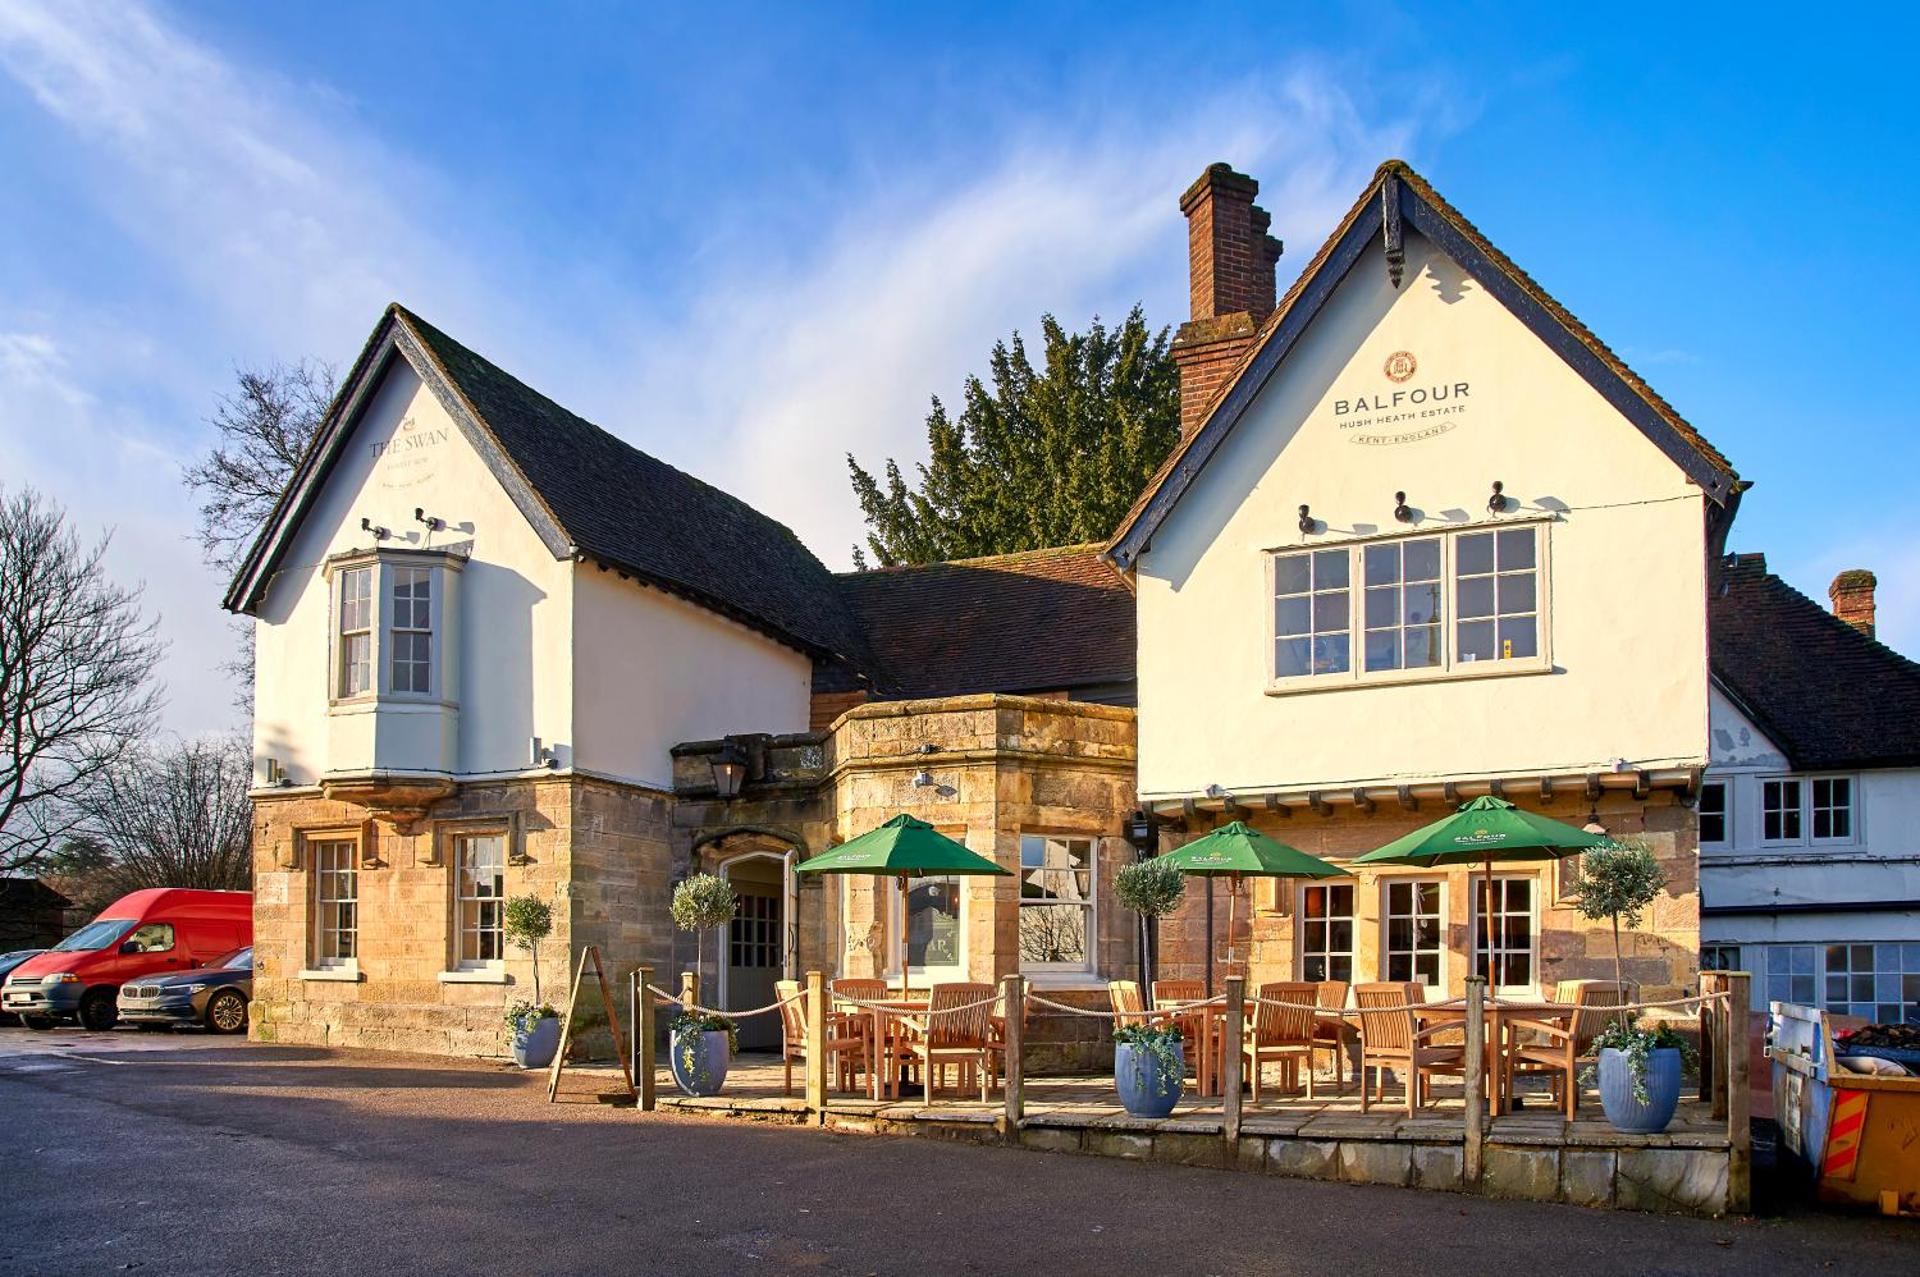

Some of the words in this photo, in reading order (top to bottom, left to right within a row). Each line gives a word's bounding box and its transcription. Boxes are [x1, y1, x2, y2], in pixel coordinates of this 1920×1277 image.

[1335, 382, 1470, 416] BALFOUR
[1340, 419, 1372, 430] HUSH
[1376, 412, 1416, 425] HEATH
[1421, 404, 1466, 418] ESTATE
[369, 438, 402, 458] THE
[405, 428, 449, 451] SWAN
